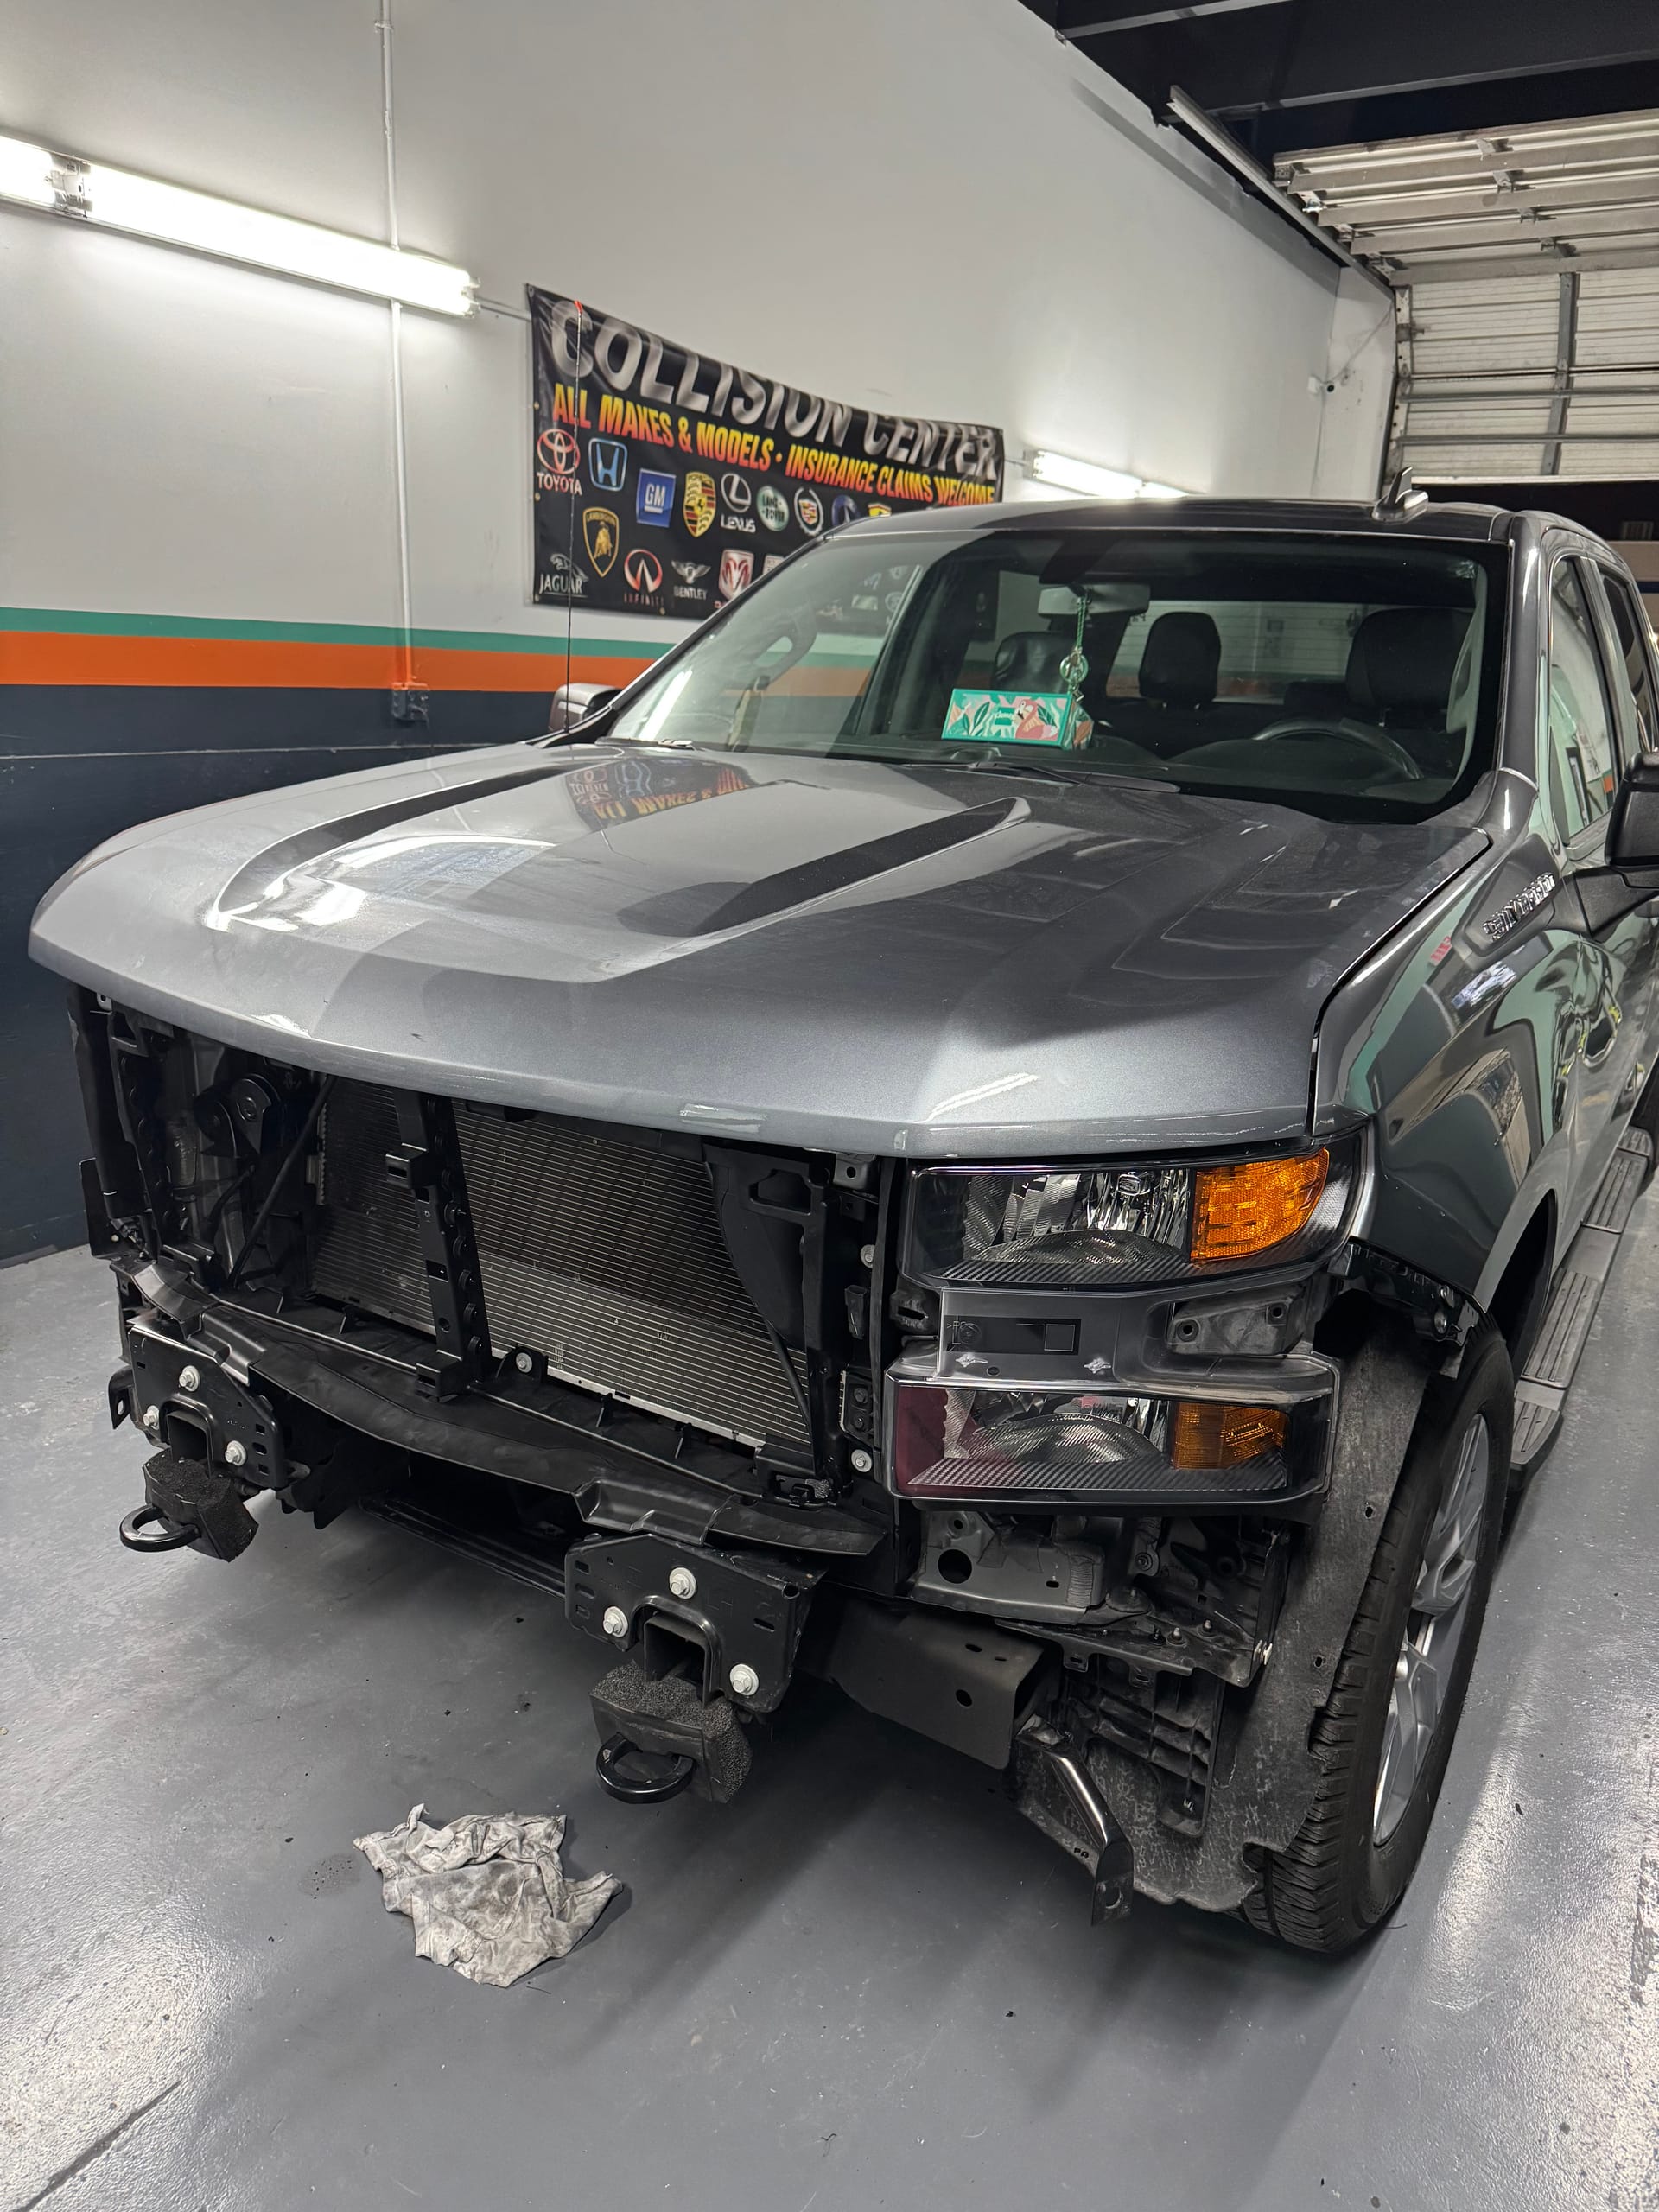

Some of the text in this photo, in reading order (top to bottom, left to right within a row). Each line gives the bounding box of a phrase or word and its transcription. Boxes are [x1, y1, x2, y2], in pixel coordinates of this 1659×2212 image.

[551, 299, 997, 480] COLLISION CENTER
[553, 383, 591, 428] ALL
[599, 395, 675, 448] MAKES
[678, 416, 692, 452] &
[696, 423, 775, 472] MODELS
[785, 444, 874, 493] INSURANCE
[876, 466, 933, 503] CLAIMS
[537, 473, 583, 496] TOYOTA
[645, 483, 665, 508] GM
[721, 514, 756, 534] LEXUS
[539, 574, 583, 595] JAGUAR
[674, 586, 708, 601] BENTLEY
